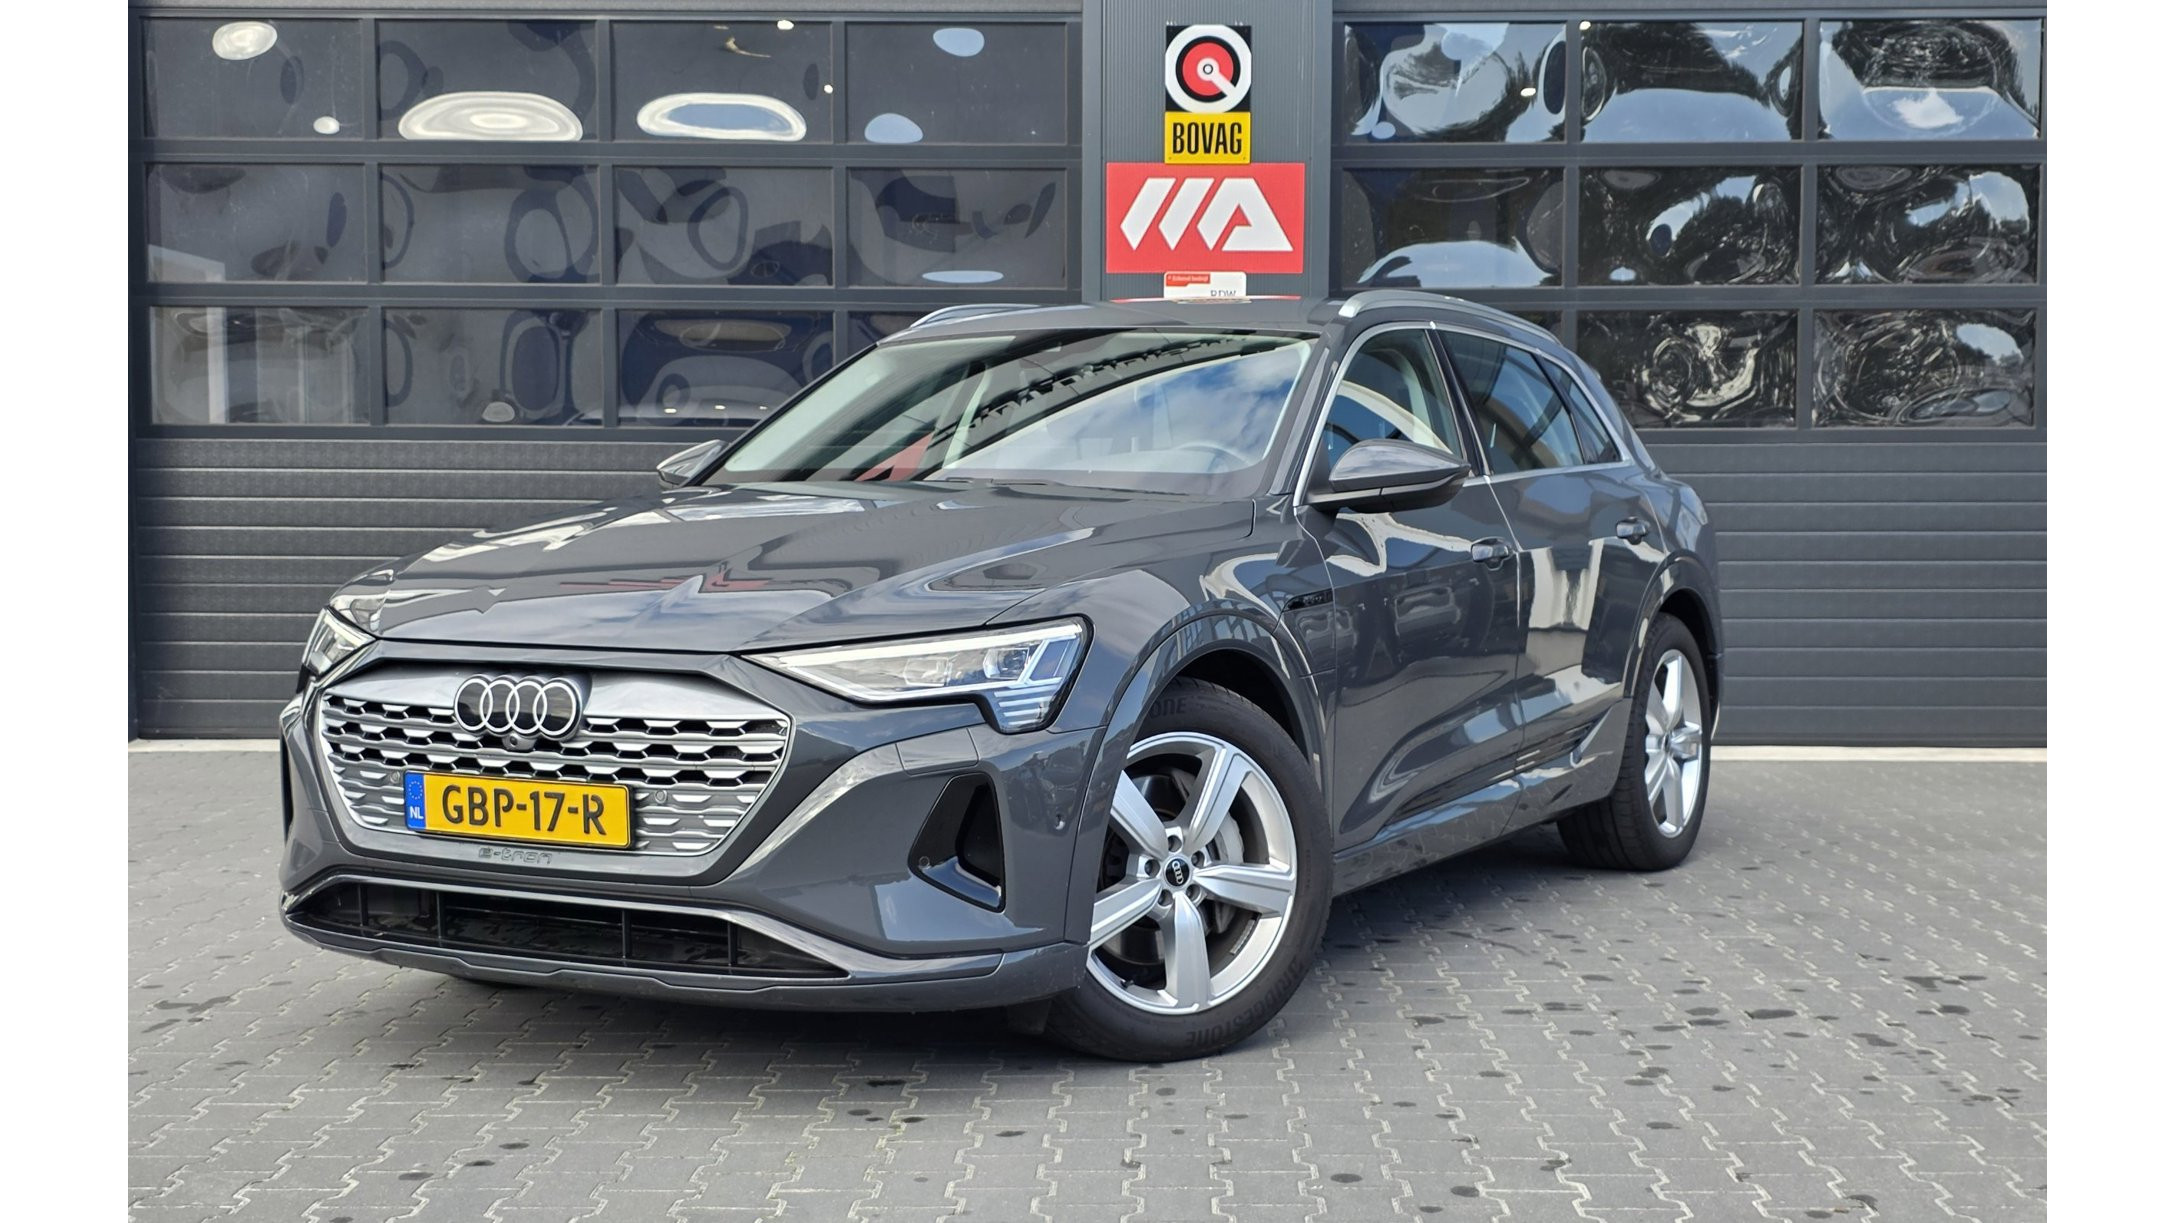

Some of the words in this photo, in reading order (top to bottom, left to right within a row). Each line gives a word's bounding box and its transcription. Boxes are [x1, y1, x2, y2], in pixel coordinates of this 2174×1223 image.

[1173, 122, 1242, 155] BOVAG
[409, 806, 425, 820] NL
[442, 784, 606, 836] GBP-17-R
